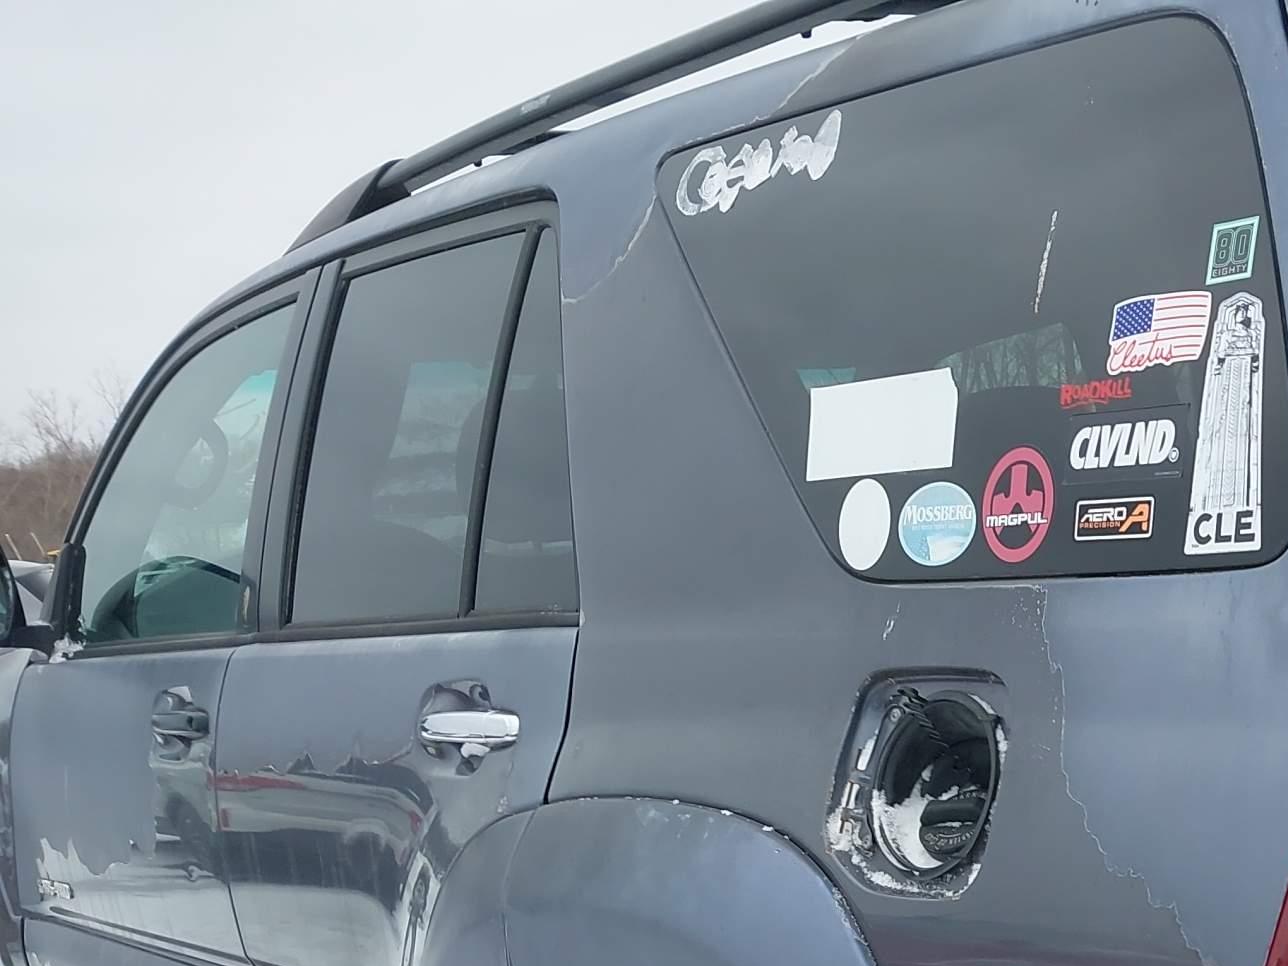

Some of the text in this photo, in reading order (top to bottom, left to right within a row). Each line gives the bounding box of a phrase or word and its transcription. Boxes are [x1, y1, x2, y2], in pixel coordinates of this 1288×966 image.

[1213, 225, 1253, 268] 80
[1211, 263, 1248, 277] EIGHTY
[1110, 332, 1174, 372] Cleetus
[1060, 377, 1132, 409] ROADKILL
[986, 512, 1048, 527] MAGPUL
[1079, 521, 1121, 529] PRECISION
[1080, 506, 1127, 523] AERO
[1193, 510, 1256, 545] CLE
